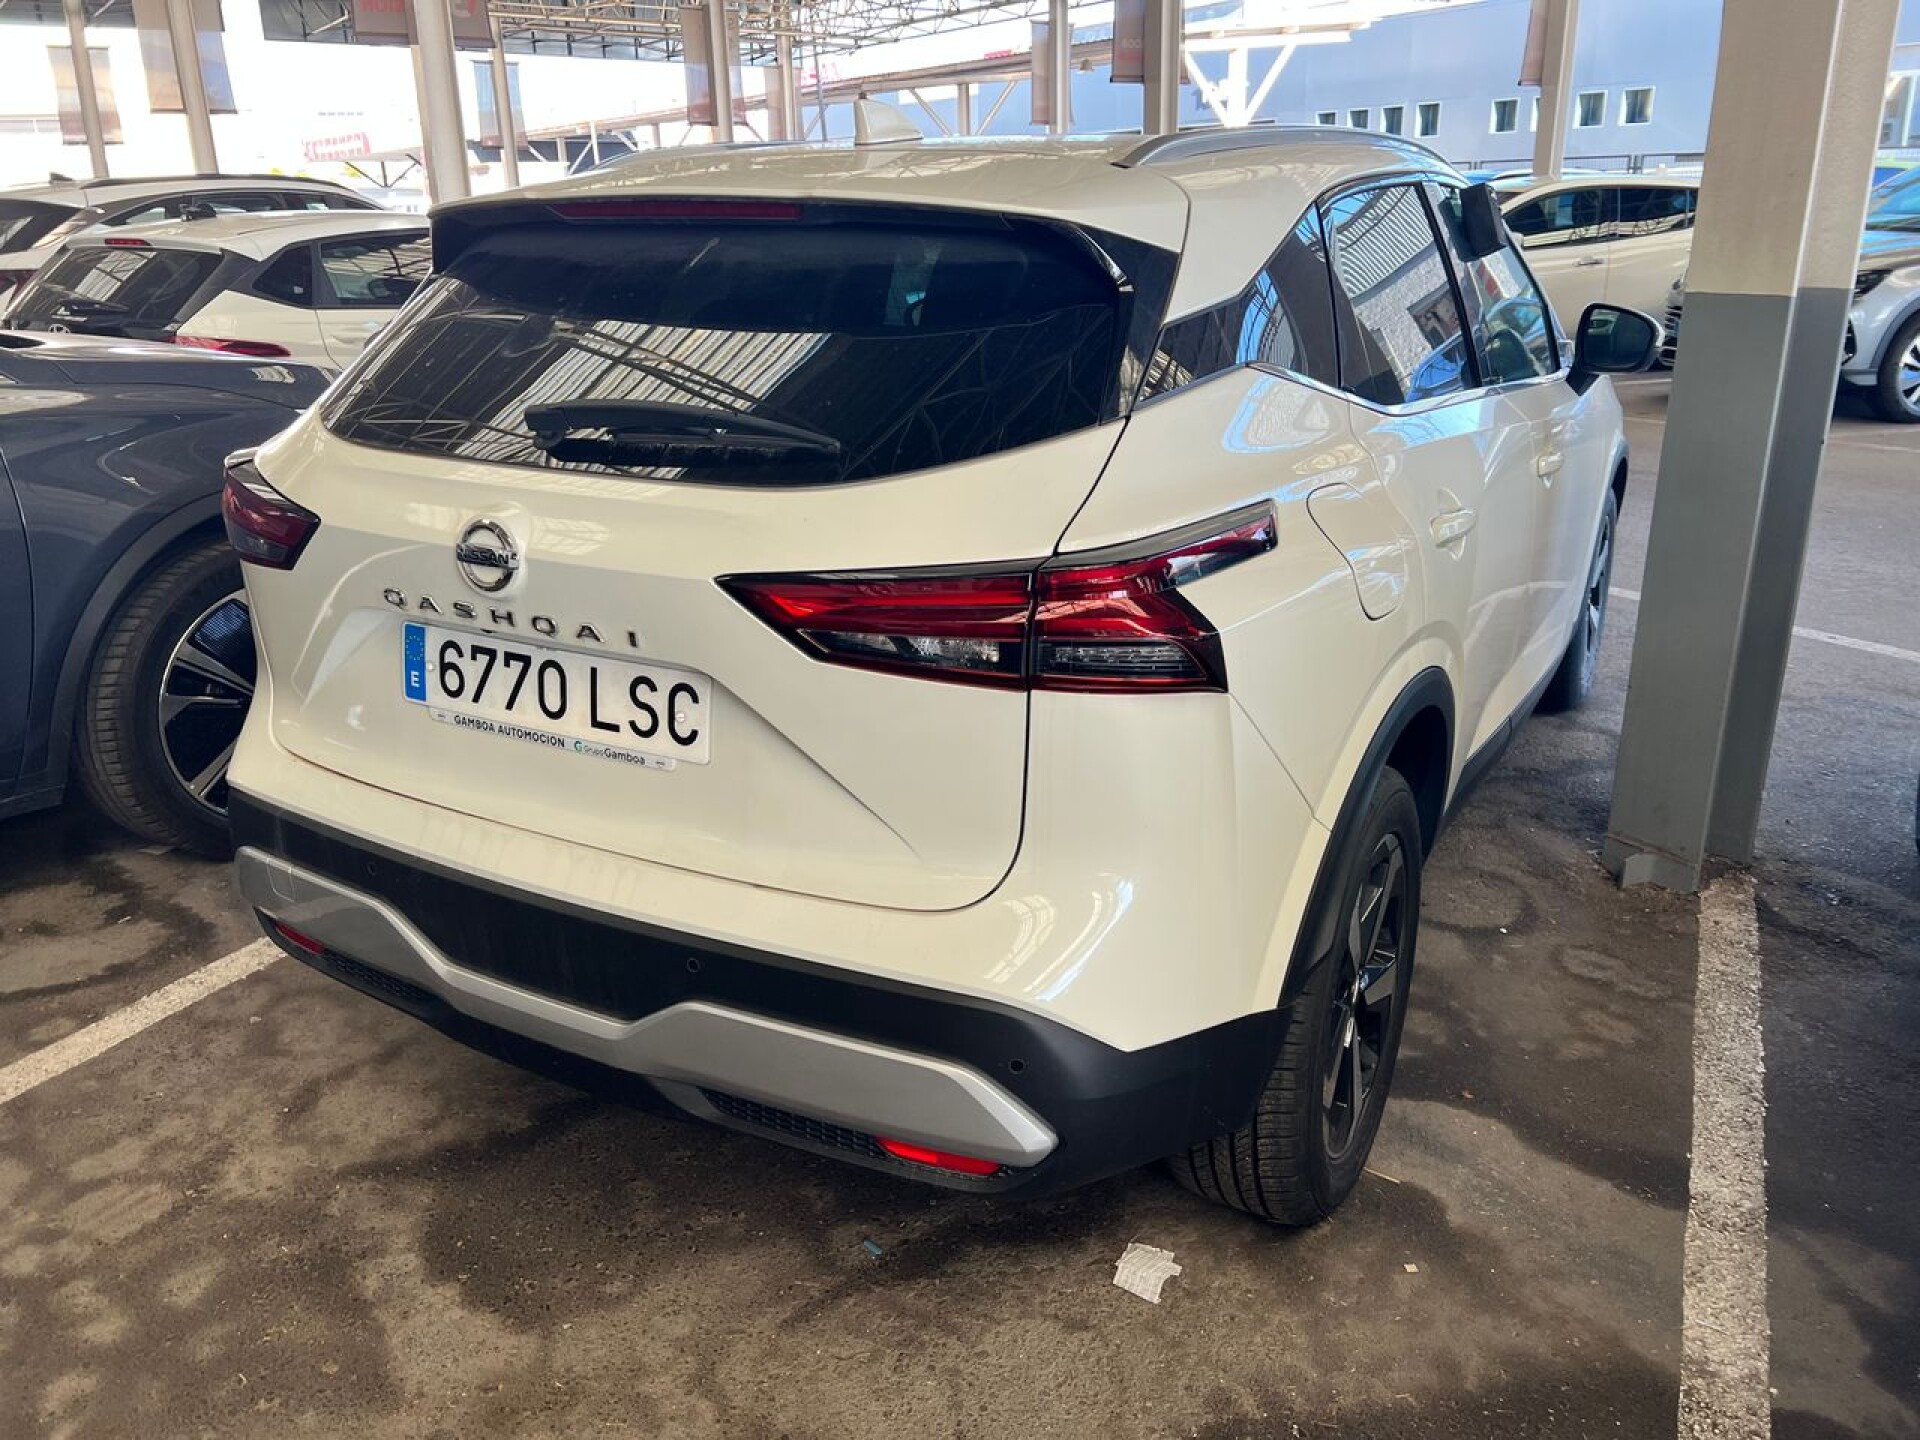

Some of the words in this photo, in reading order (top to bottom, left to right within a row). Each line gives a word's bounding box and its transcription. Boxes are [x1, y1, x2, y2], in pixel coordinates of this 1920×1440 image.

[456, 544, 511, 567] NISSAN
[384, 588, 638, 648] QASHQAI
[410, 671, 420, 688] E
[439, 640, 567, 720] 6770
[590, 666, 699, 746] LSC
[454, 715, 495, 733] GAMBOA
[498, 724, 565, 748] AUTOMOCION
